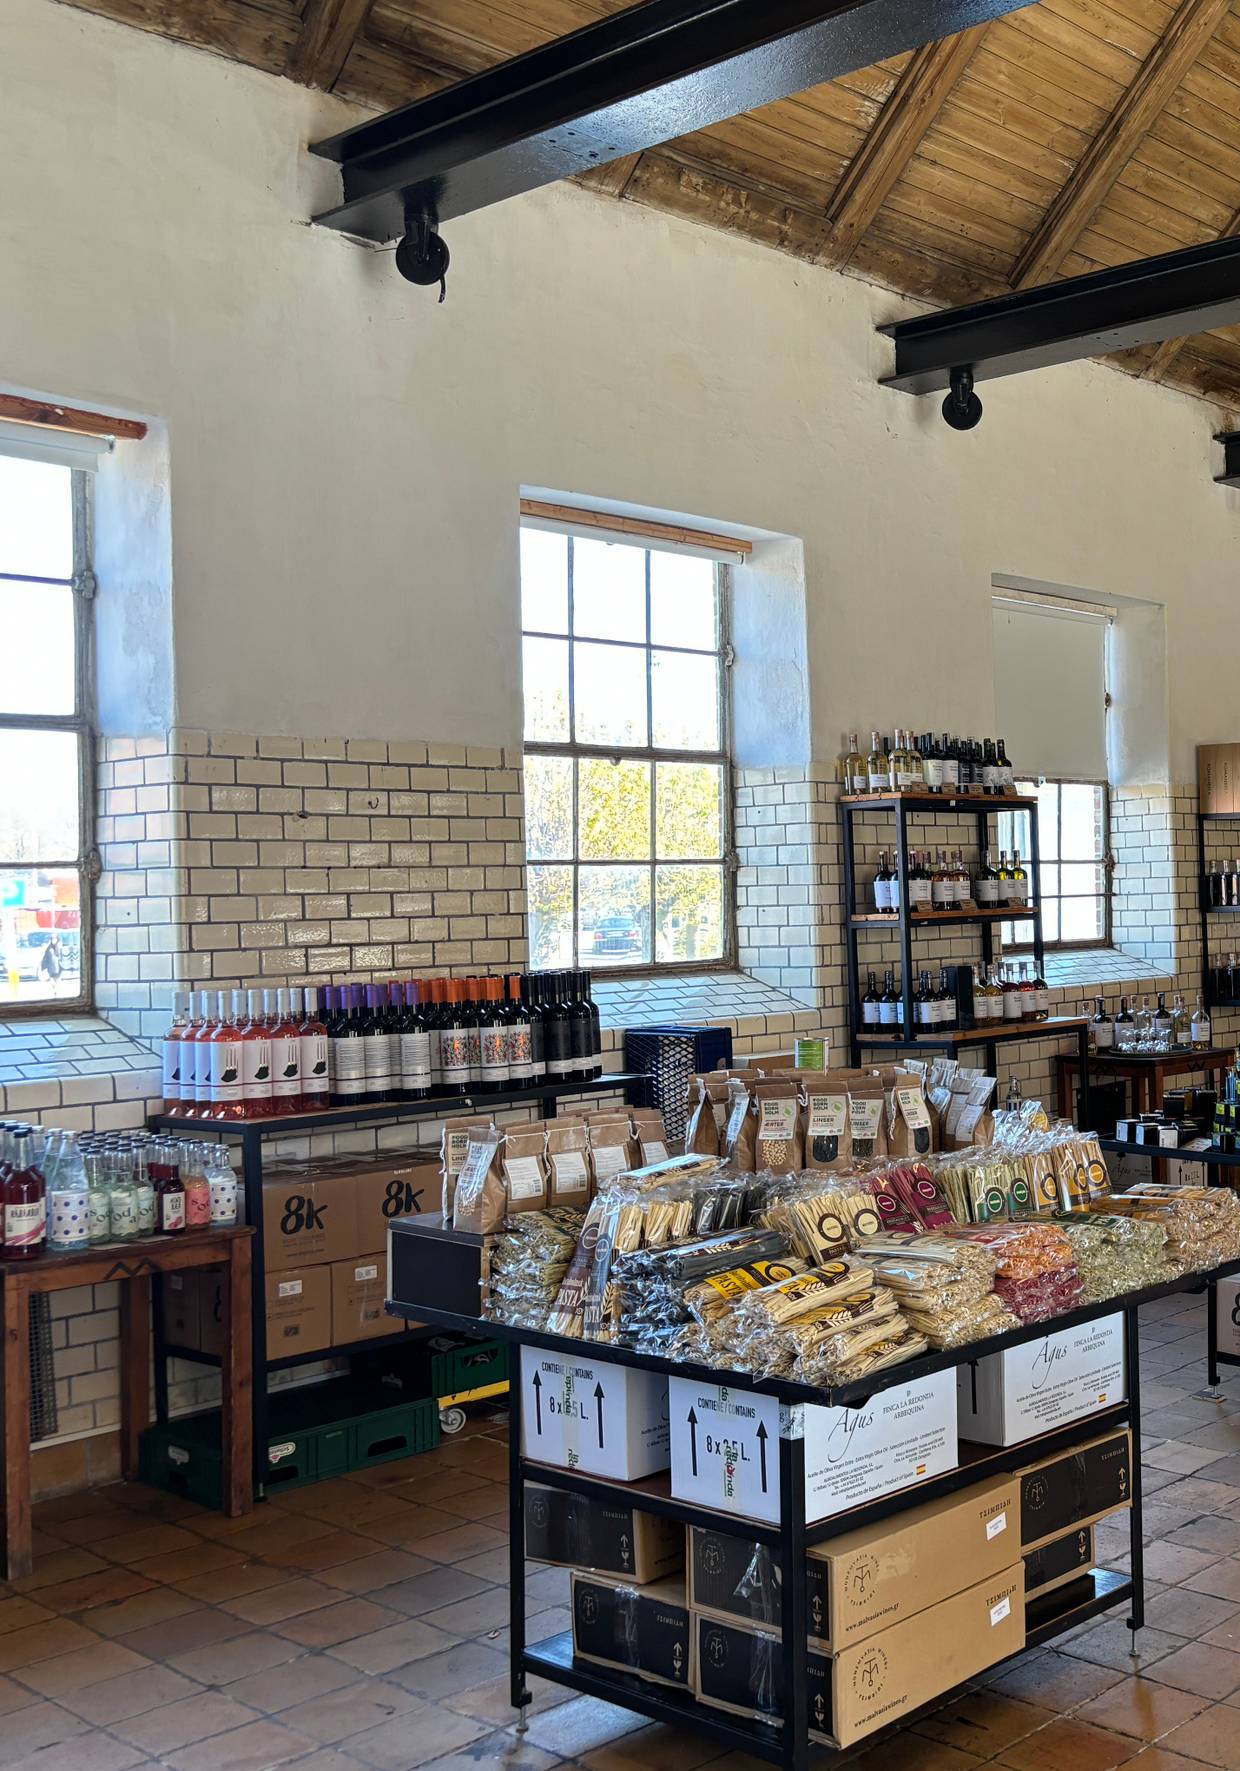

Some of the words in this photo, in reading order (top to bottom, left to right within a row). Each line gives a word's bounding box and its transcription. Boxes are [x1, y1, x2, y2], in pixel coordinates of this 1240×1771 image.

[382, 1180, 425, 1217] 8k
[280, 1195, 328, 1235] 8k
[713, 1274, 744, 1296] PASTA
[541, 1361, 565, 1375] CONTIENE
[1032, 1339, 1067, 1389] Agus
[549, 1396, 556, 1413] 8
[697, 1397, 724, 1414] CONTIENE
[728, 1403, 756, 1419] CONTAINS
[882, 1403, 899, 1415] FINCA
[908, 1391, 934, 1407] REDONDA
[893, 1405, 925, 1419] ARBEQUINA
[706, 1435, 712, 1452] 8
[828, 1408, 874, 1463] Agus
